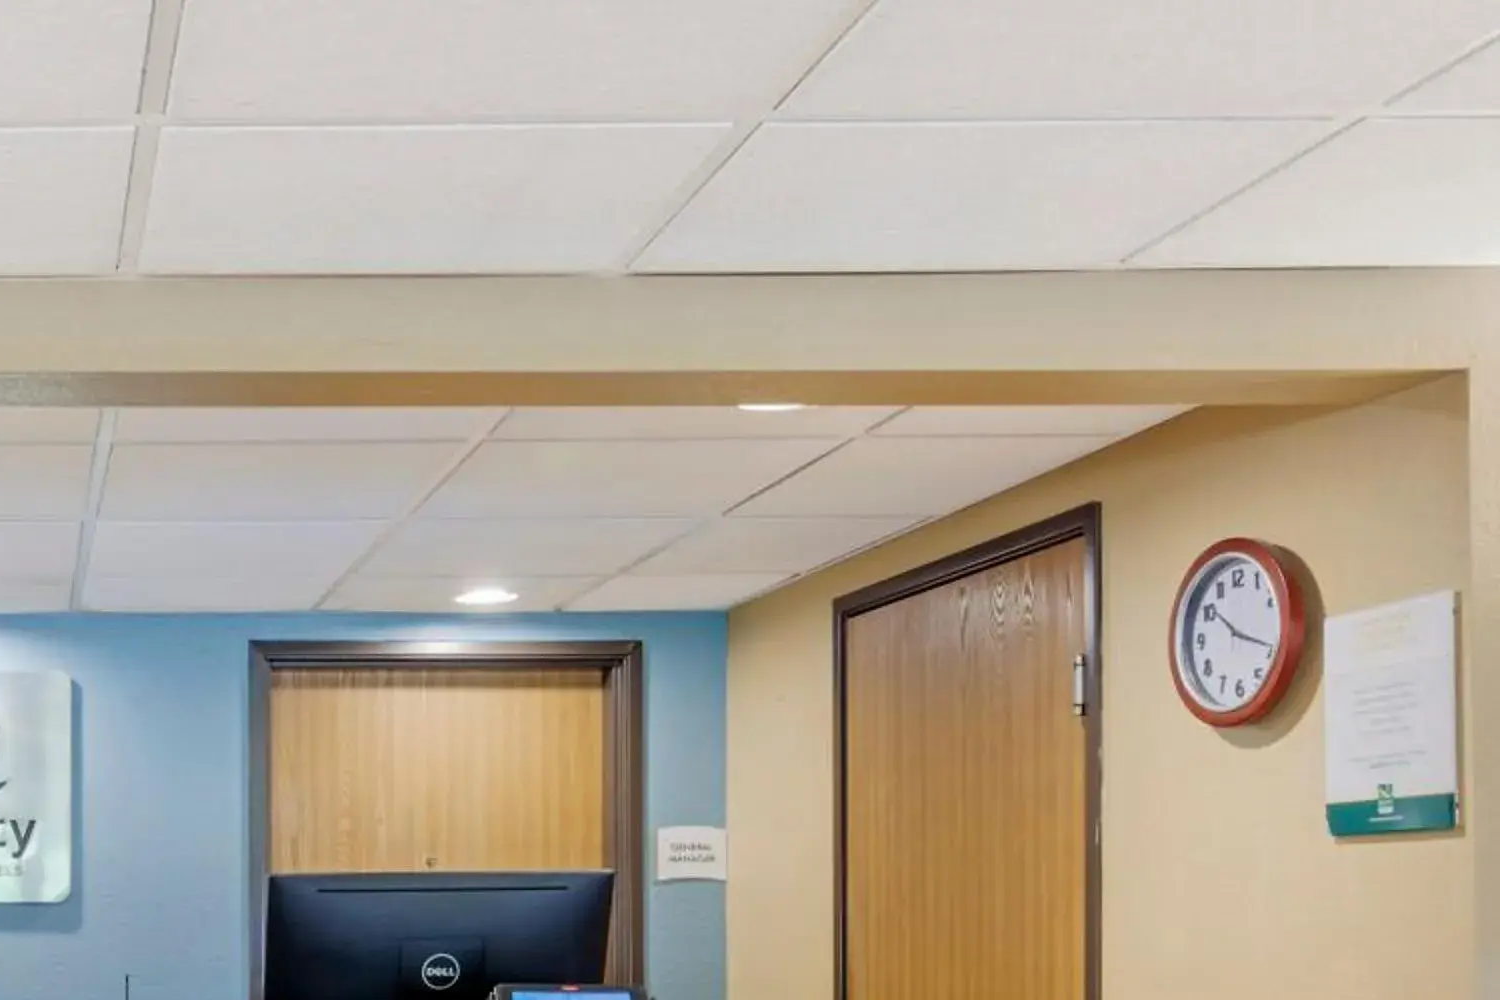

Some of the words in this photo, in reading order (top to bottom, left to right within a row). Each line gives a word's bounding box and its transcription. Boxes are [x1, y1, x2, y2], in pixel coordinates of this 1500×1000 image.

[1231, 569, 1245, 588] 12
[1254, 571, 1260, 590] 1
[1216, 582, 1224, 599] 11
[1203, 603, 1216, 622] 10
[1197, 632, 1205, 650] 9
[1204, 658, 1212, 677] 8
[1219, 675, 1227, 694] 7
[1235, 679, 1245, 697] 6
[426, 966, 455, 977] DELL
